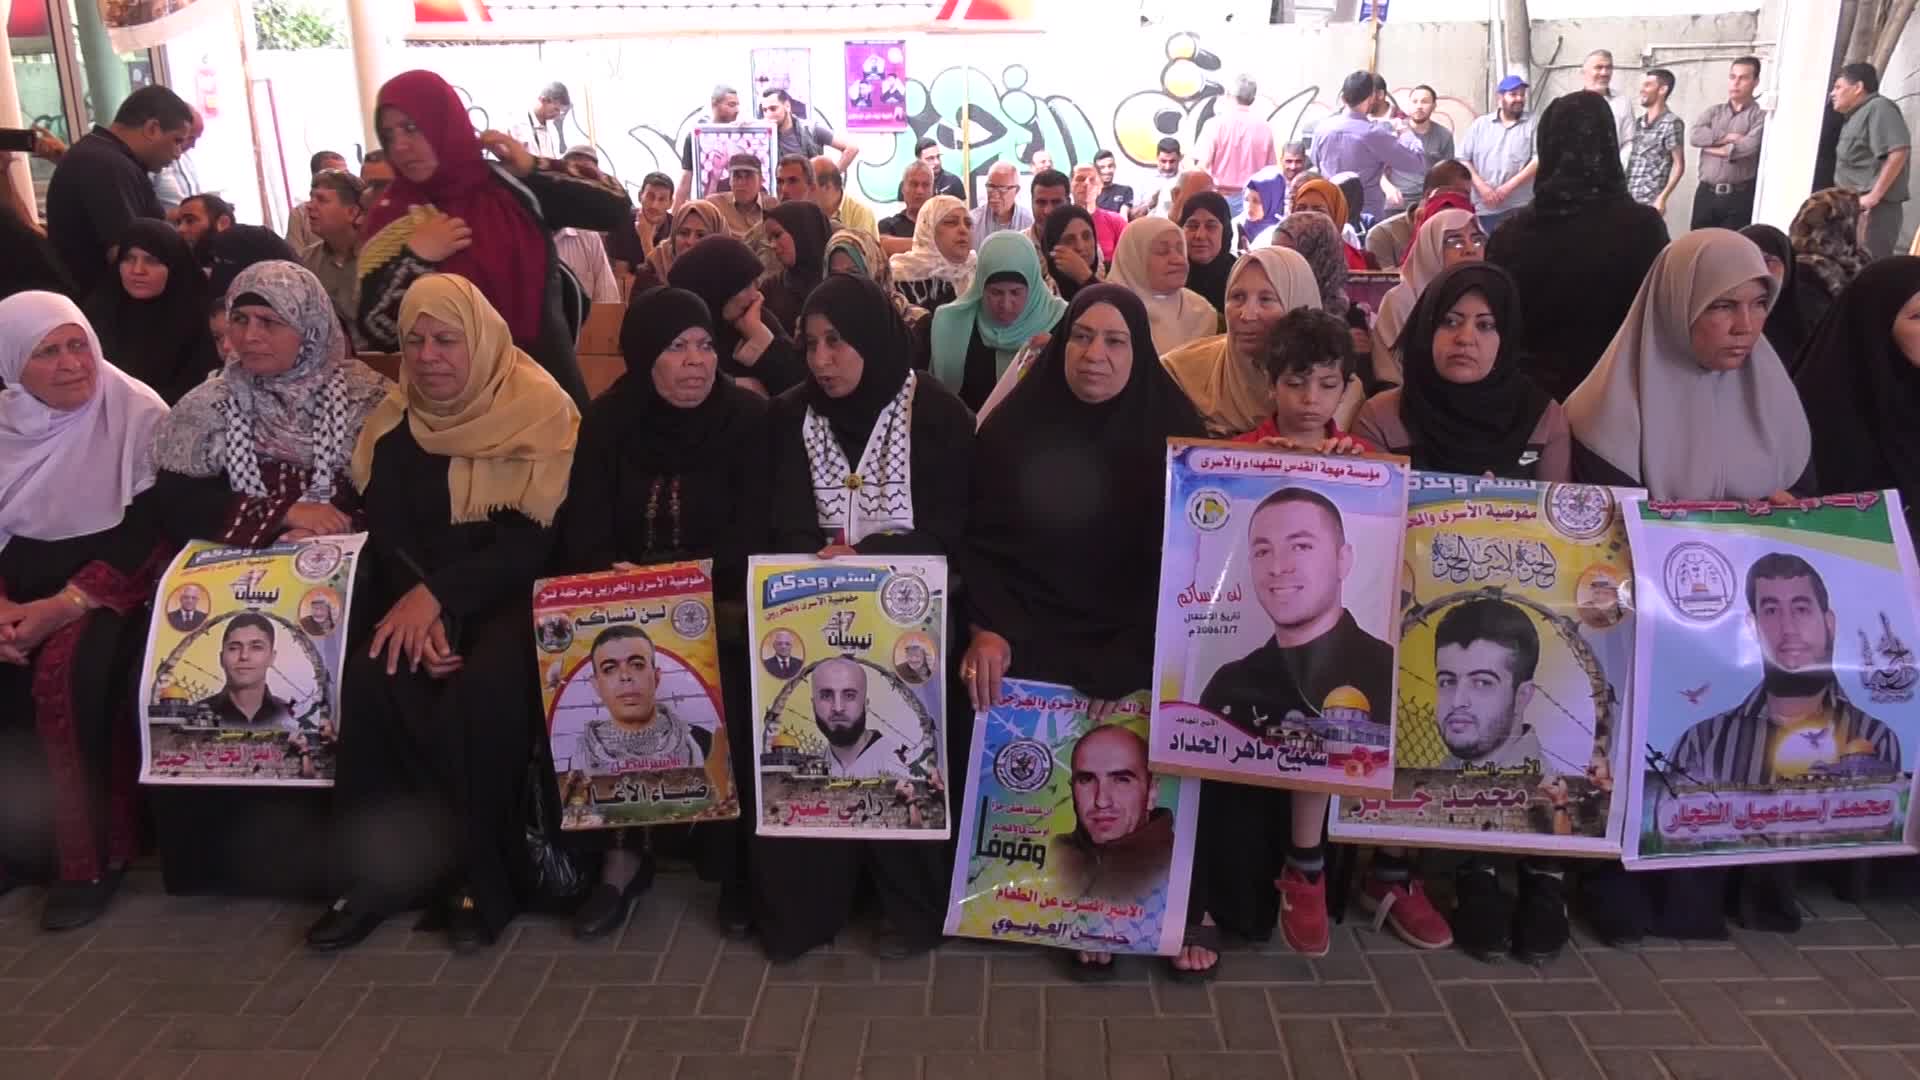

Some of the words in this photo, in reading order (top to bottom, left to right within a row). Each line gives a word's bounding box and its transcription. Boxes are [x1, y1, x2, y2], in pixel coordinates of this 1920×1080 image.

[1243, 457, 1282, 471] للشهداء
[1284, 462, 1318, 474] القدس
[1320, 462, 1344, 479] مهجة
[1407, 472, 1467, 494] وحدك
[1438, 500, 1482, 524] الأسرى
[1487, 503, 1537, 521] مفوضية
[769, 574, 829, 598] وحدكم
[831, 573, 876, 589] لستم
[1177, 577, 1222, 609] نساكم
[575, 606, 637, 630] ننساكم
[640, 604, 667, 624] لن
[828, 631, 873, 651] نيسان
[1168, 731, 1228, 759] الحداد
[1229, 739, 1275, 764] ماهر
[1276, 745, 1328, 772] سميح
[591, 777, 648, 805] الأغا
[650, 777, 710, 804] ضياء
[1441, 785, 1529, 809] محمد
[1663, 799, 1731, 833] النجار
[1831, 797, 1893, 819] محمد
[975, 795, 1046, 869] وقوفا
[995, 886, 1038, 903] الطعام
[1039, 891, 1059, 908] عن
[991, 917, 1068, 937] العويوي
[1070, 925, 1131, 945] حسن
